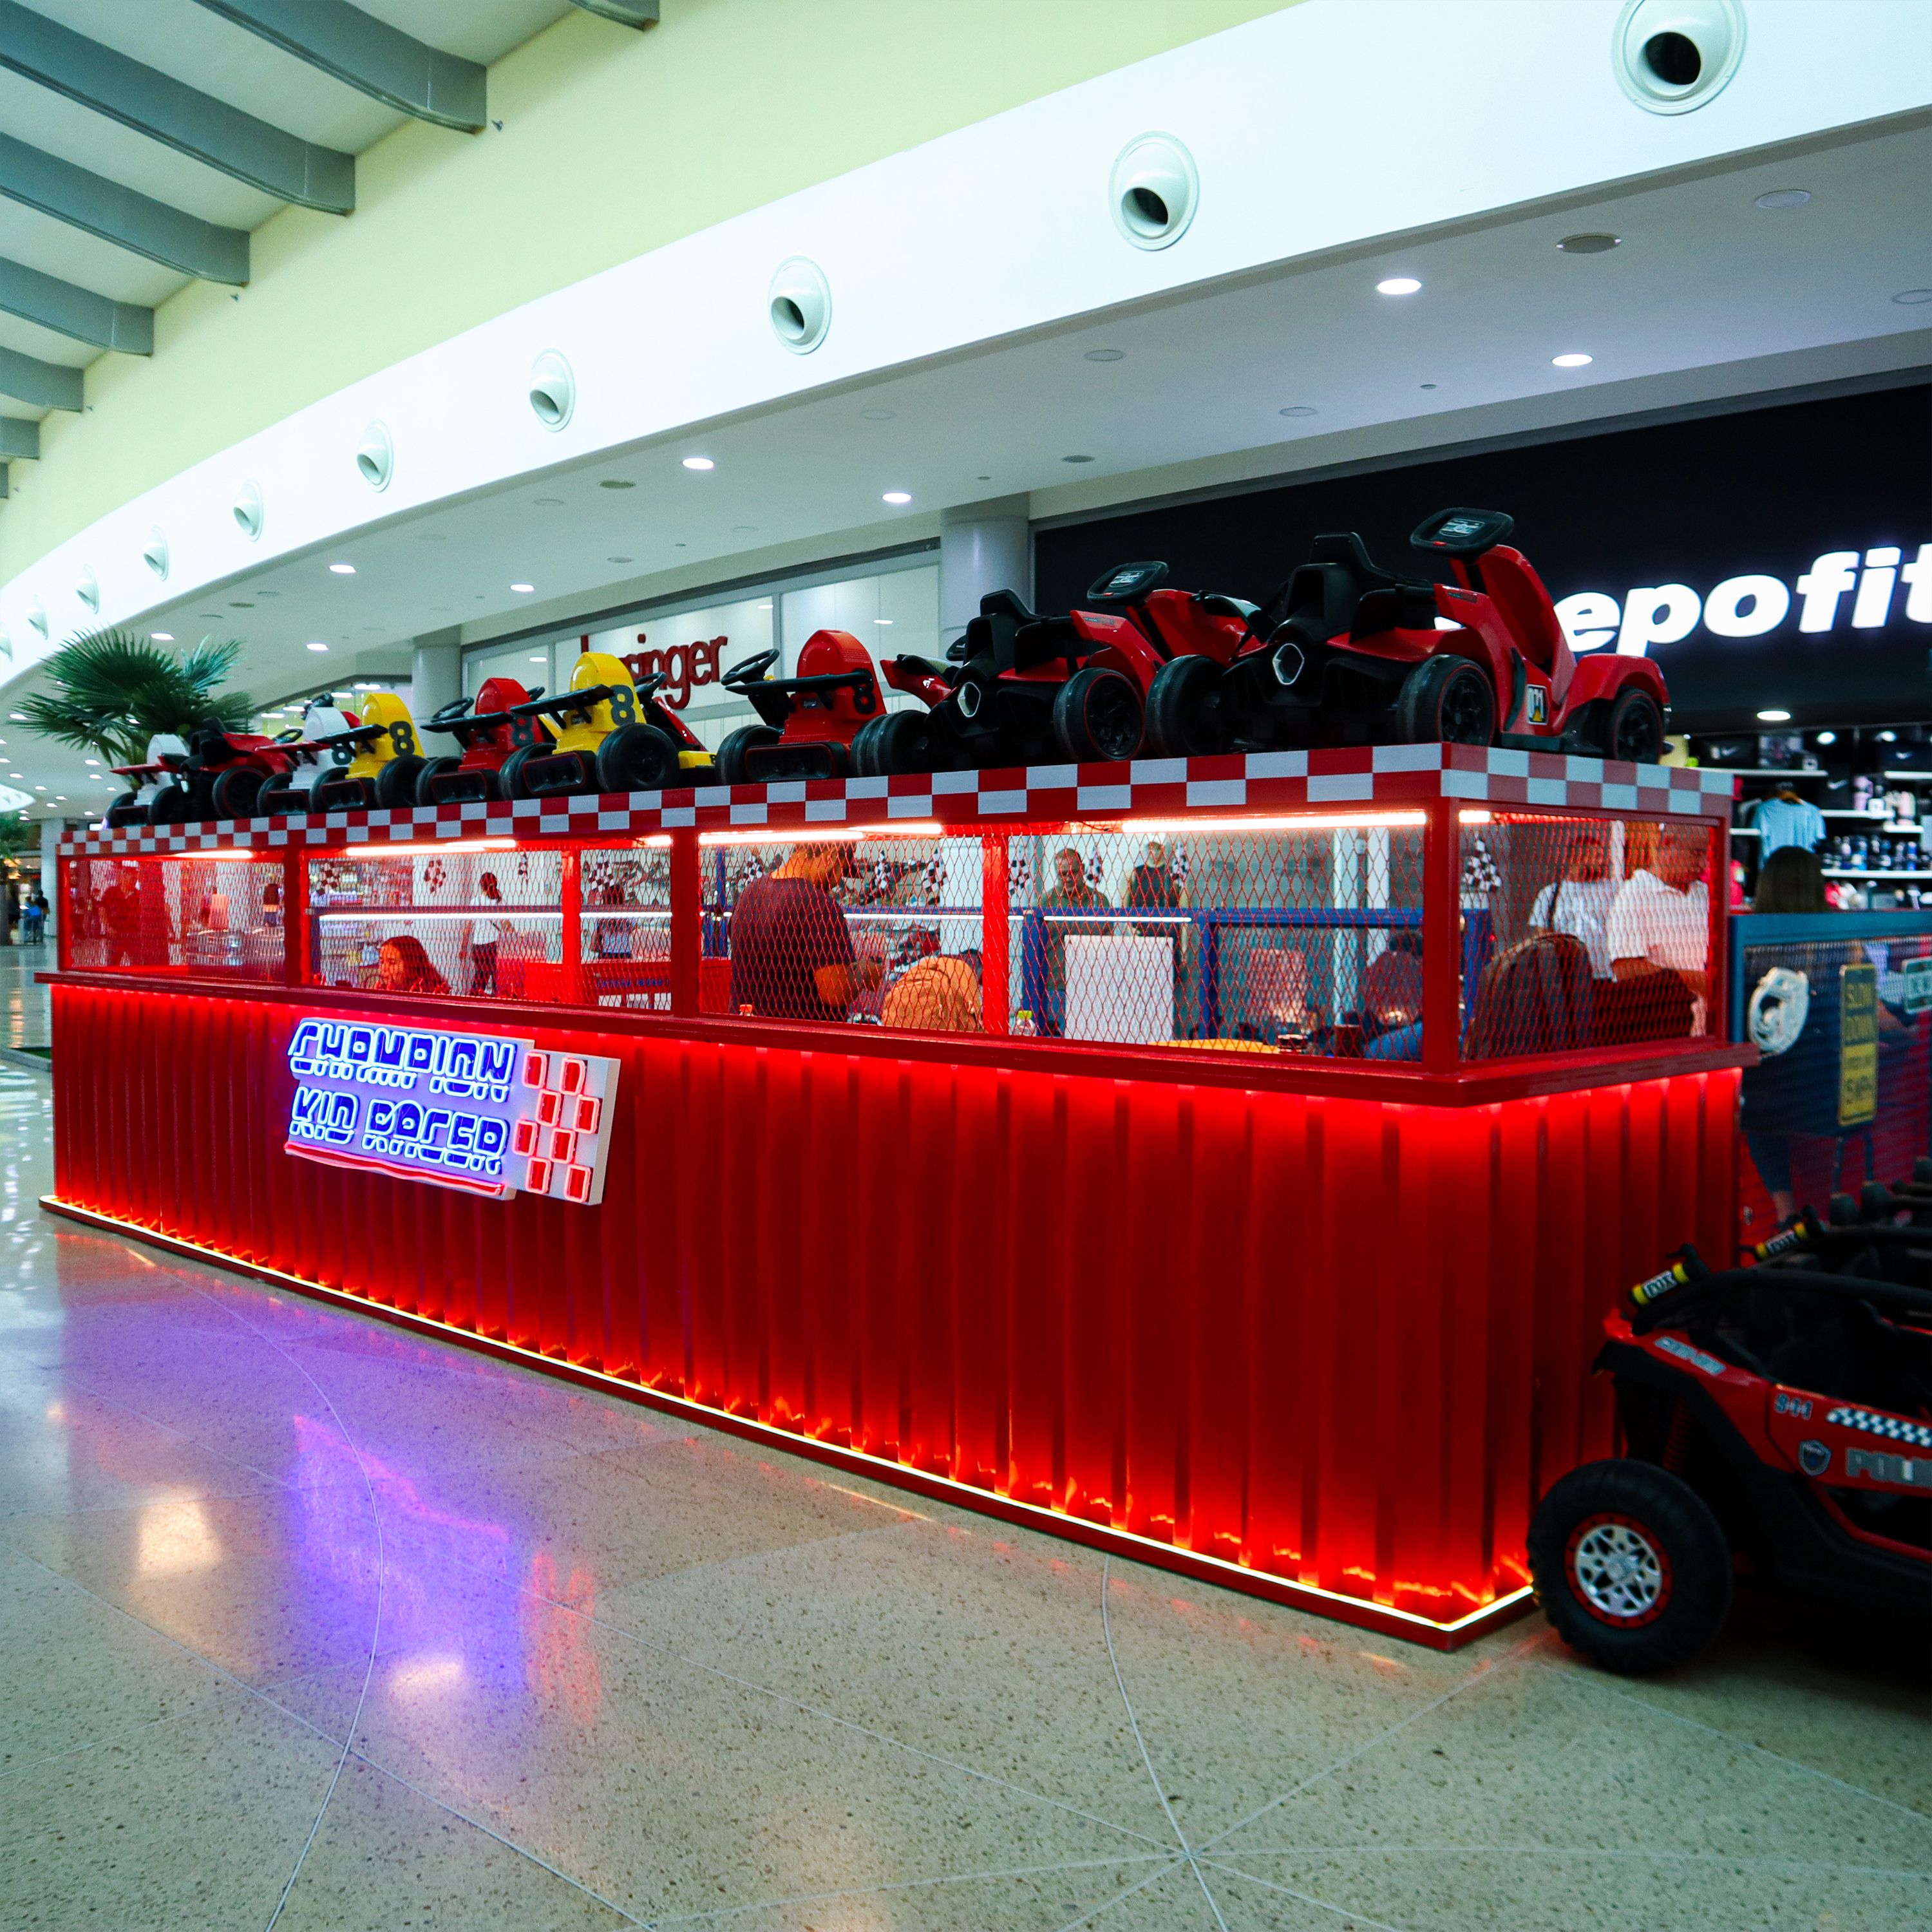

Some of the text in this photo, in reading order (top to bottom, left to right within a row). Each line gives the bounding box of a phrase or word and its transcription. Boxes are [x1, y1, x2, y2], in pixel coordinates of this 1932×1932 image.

[609, 685, 636, 727] 8
[389, 721, 415, 757] 8
[513, 712, 534, 747] 8
[288, 1022, 518, 1103] CHAMPION
[289, 1086, 511, 1175] KID RACER
